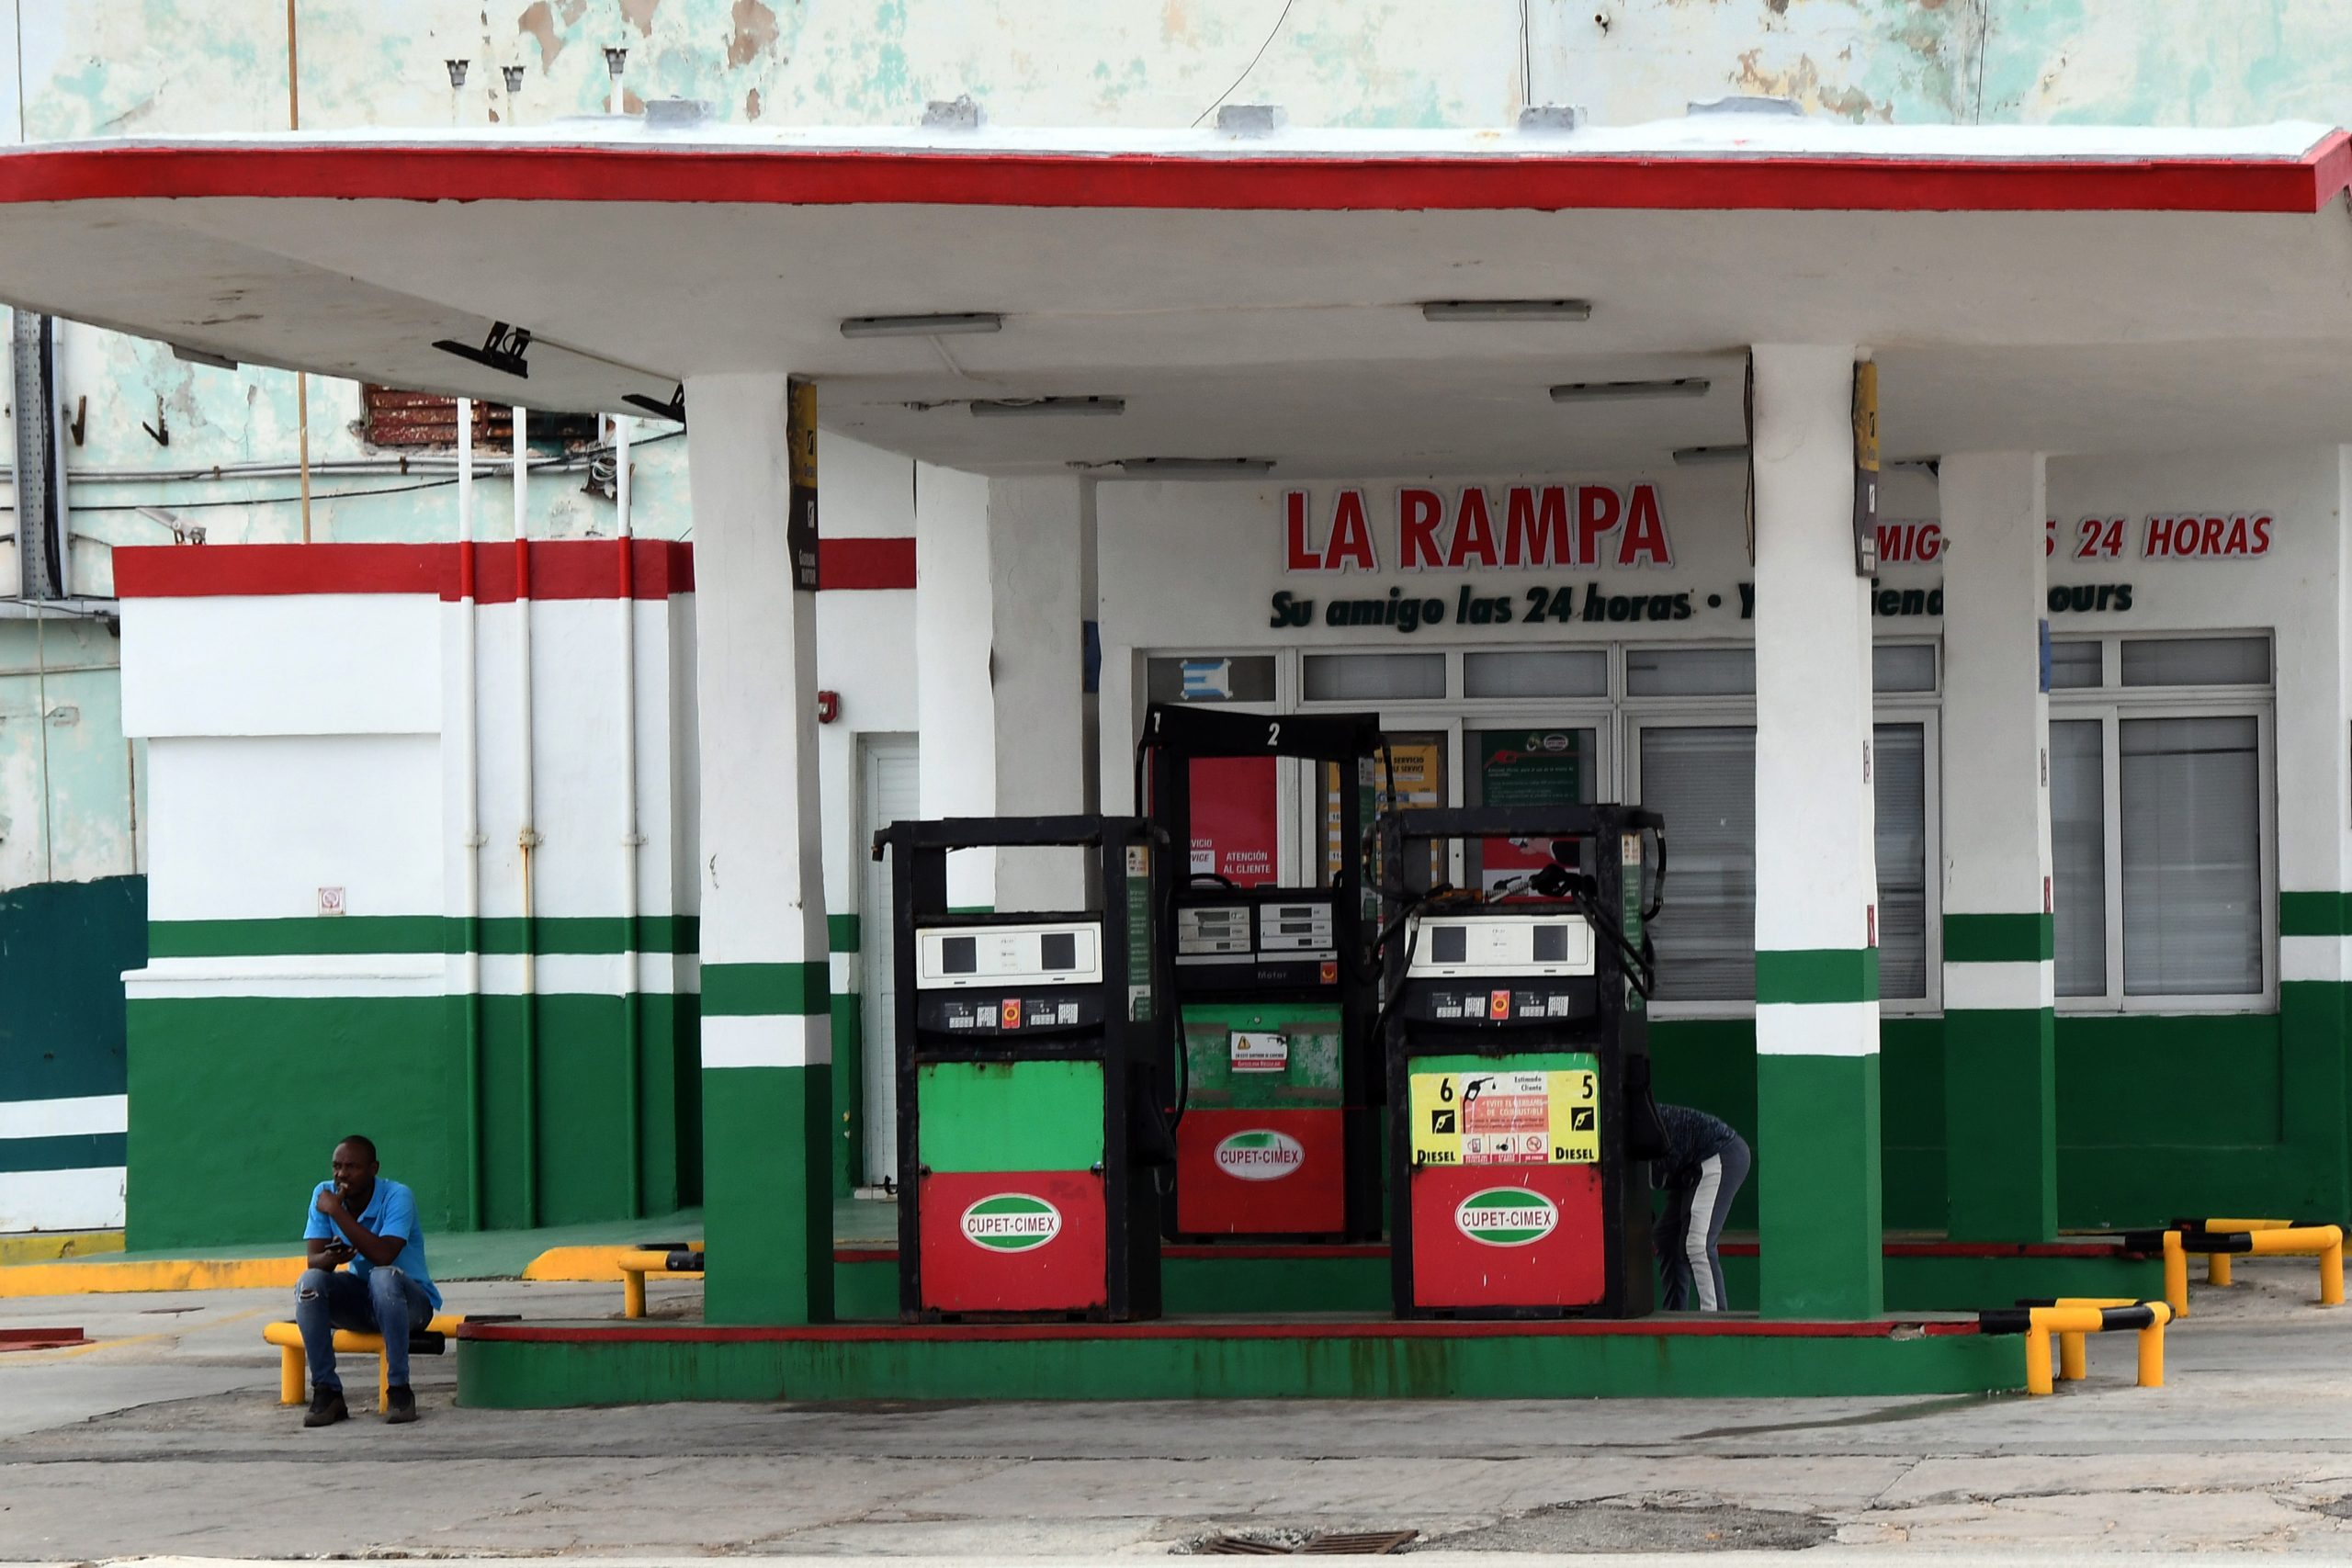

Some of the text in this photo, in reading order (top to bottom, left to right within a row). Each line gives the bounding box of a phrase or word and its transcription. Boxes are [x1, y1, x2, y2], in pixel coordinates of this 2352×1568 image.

[1287, 485, 1669, 570] LA RAMPA
[1877, 524, 1941, 562] MIG
[2077, 518, 2126, 558] 24
[2145, 516, 2273, 557] HORAS
[1270, 577, 2132, 633] Su amigo las 24 horas iend ours
[1153, 711, 1161, 734] 1
[1266, 722, 1281, 747] 2
[1191, 839, 1213, 848] VICIO
[1192, 853, 1210, 863] VICE
[1226, 849, 1268, 862] ATENCIÓN
[1223, 864, 1271, 874] AL CLIENTE
[1440, 1077, 1453, 1102] 6
[1582, 1075, 1593, 1100] 5
[1221, 1150, 1298, 1164] CUPET-CIMEX
[1418, 1149, 1455, 1162] DIESEL
[1555, 1147, 1594, 1160] DIESEL
[967, 1217, 1055, 1233] CUPET-CIMEX
[1462, 1211, 1551, 1226] CUPET-CIMEX
